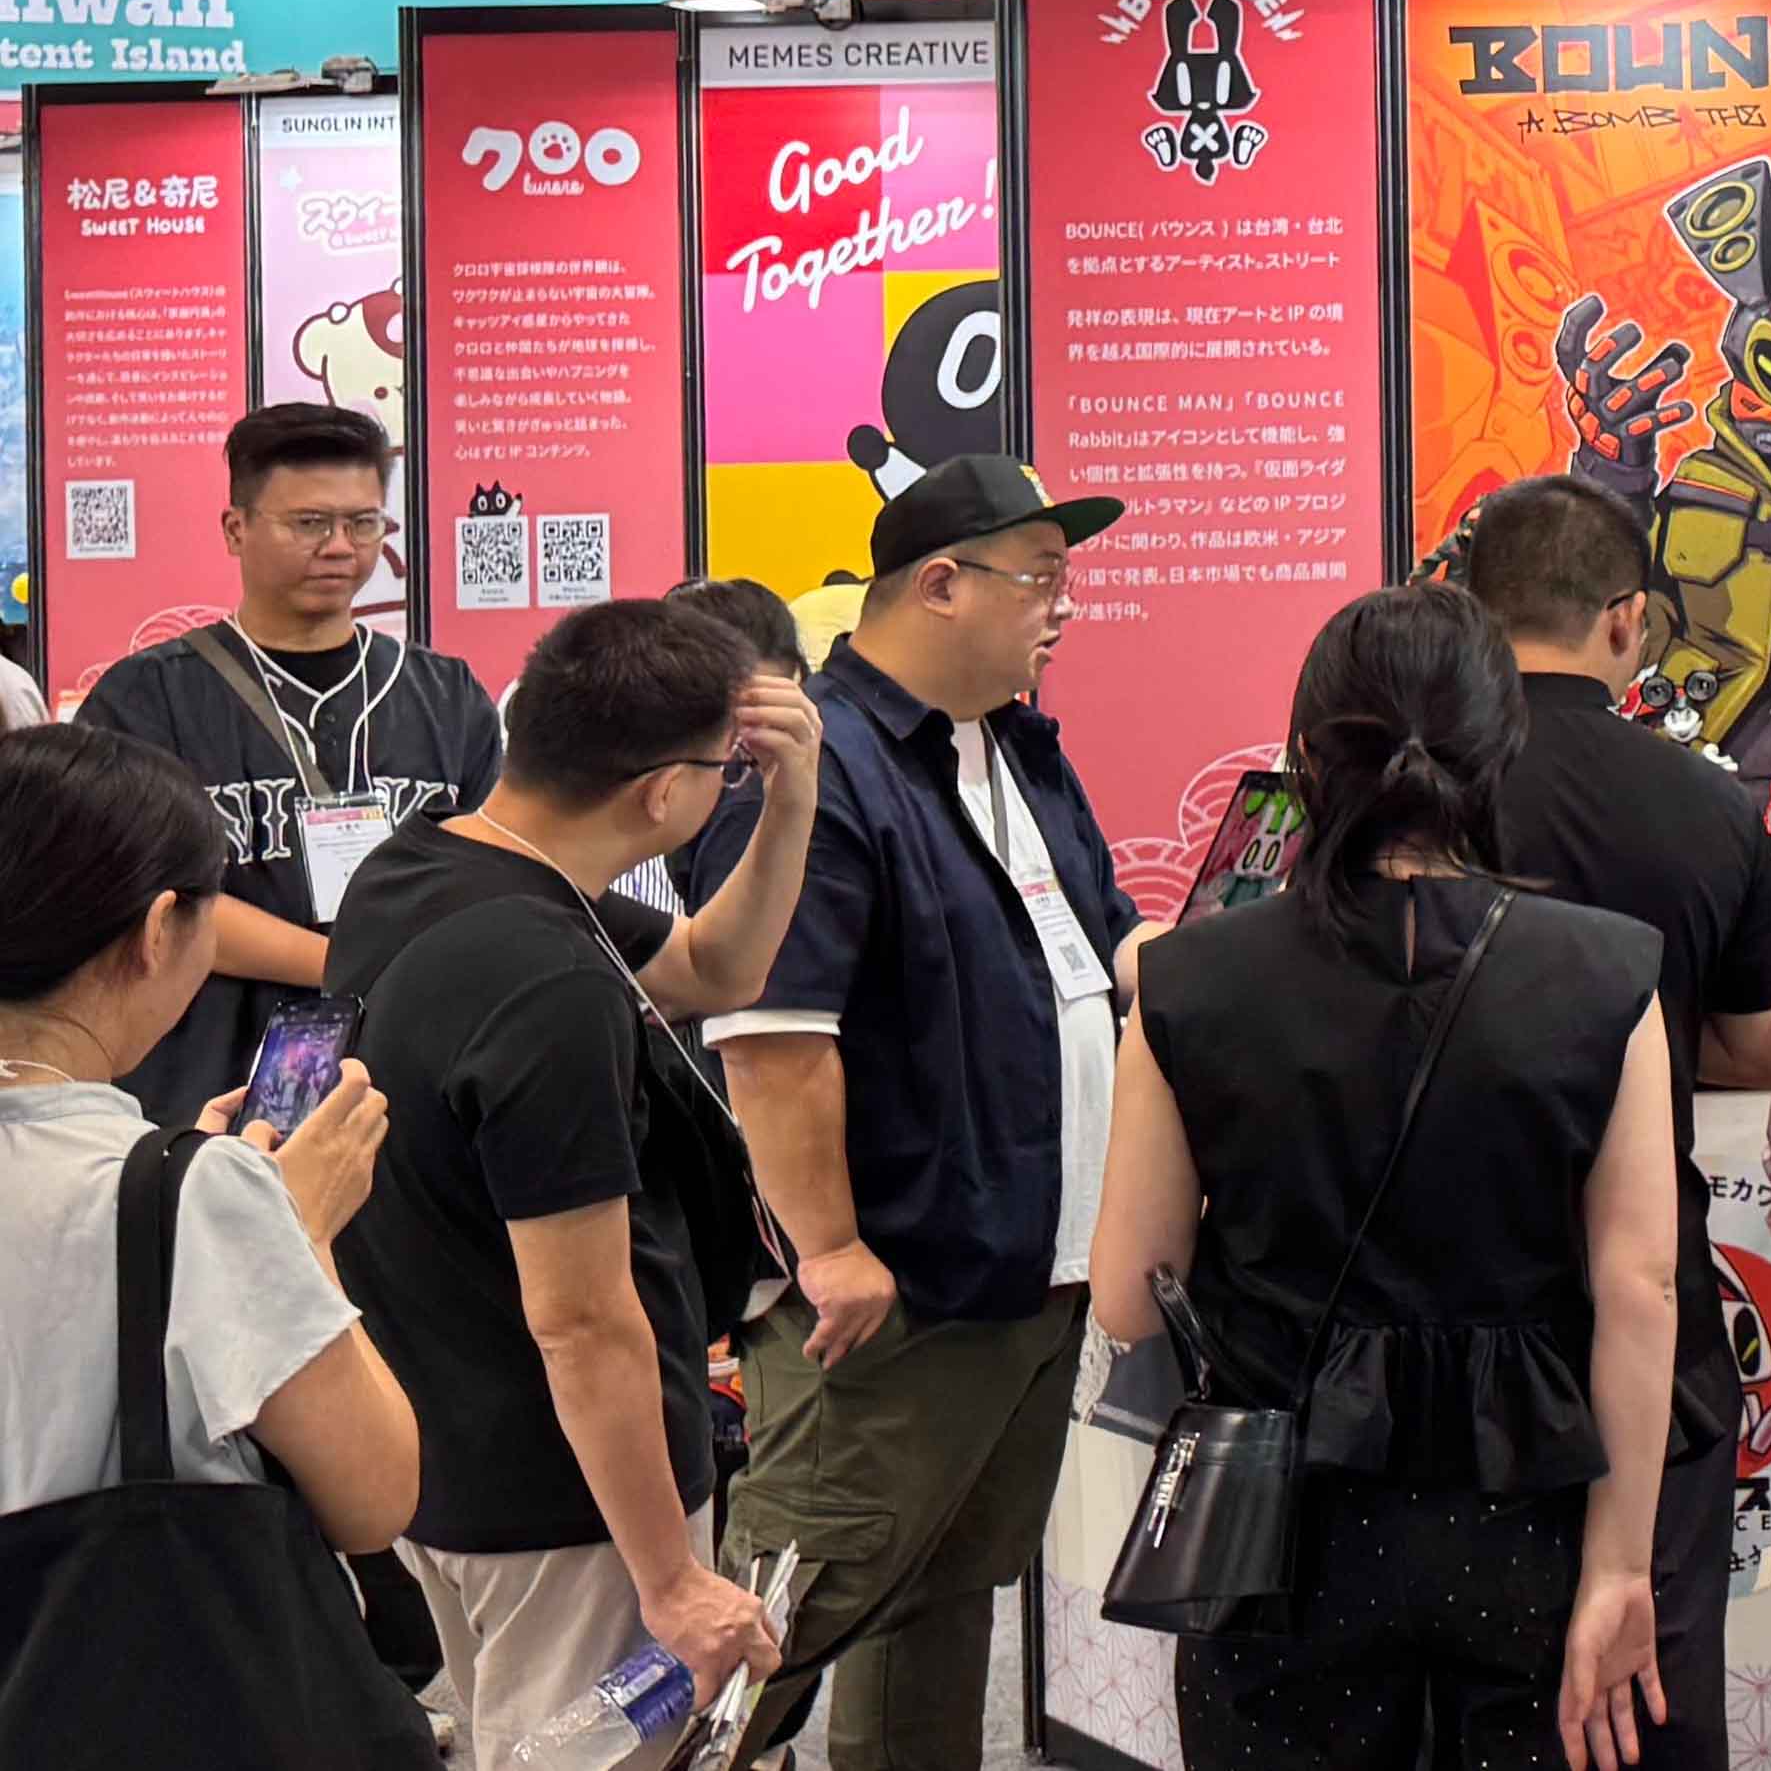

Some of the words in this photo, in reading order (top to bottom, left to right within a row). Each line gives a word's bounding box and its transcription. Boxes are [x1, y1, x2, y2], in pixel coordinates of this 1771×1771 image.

[111, 38, 247, 74] Island
[728, 43, 833, 70] MEMES
[844, 40, 989, 67] CREATIVE
[767, 105, 925, 214] Good
[80, 216, 137, 237] SWEET
[146, 215, 206, 235] HOUSE
